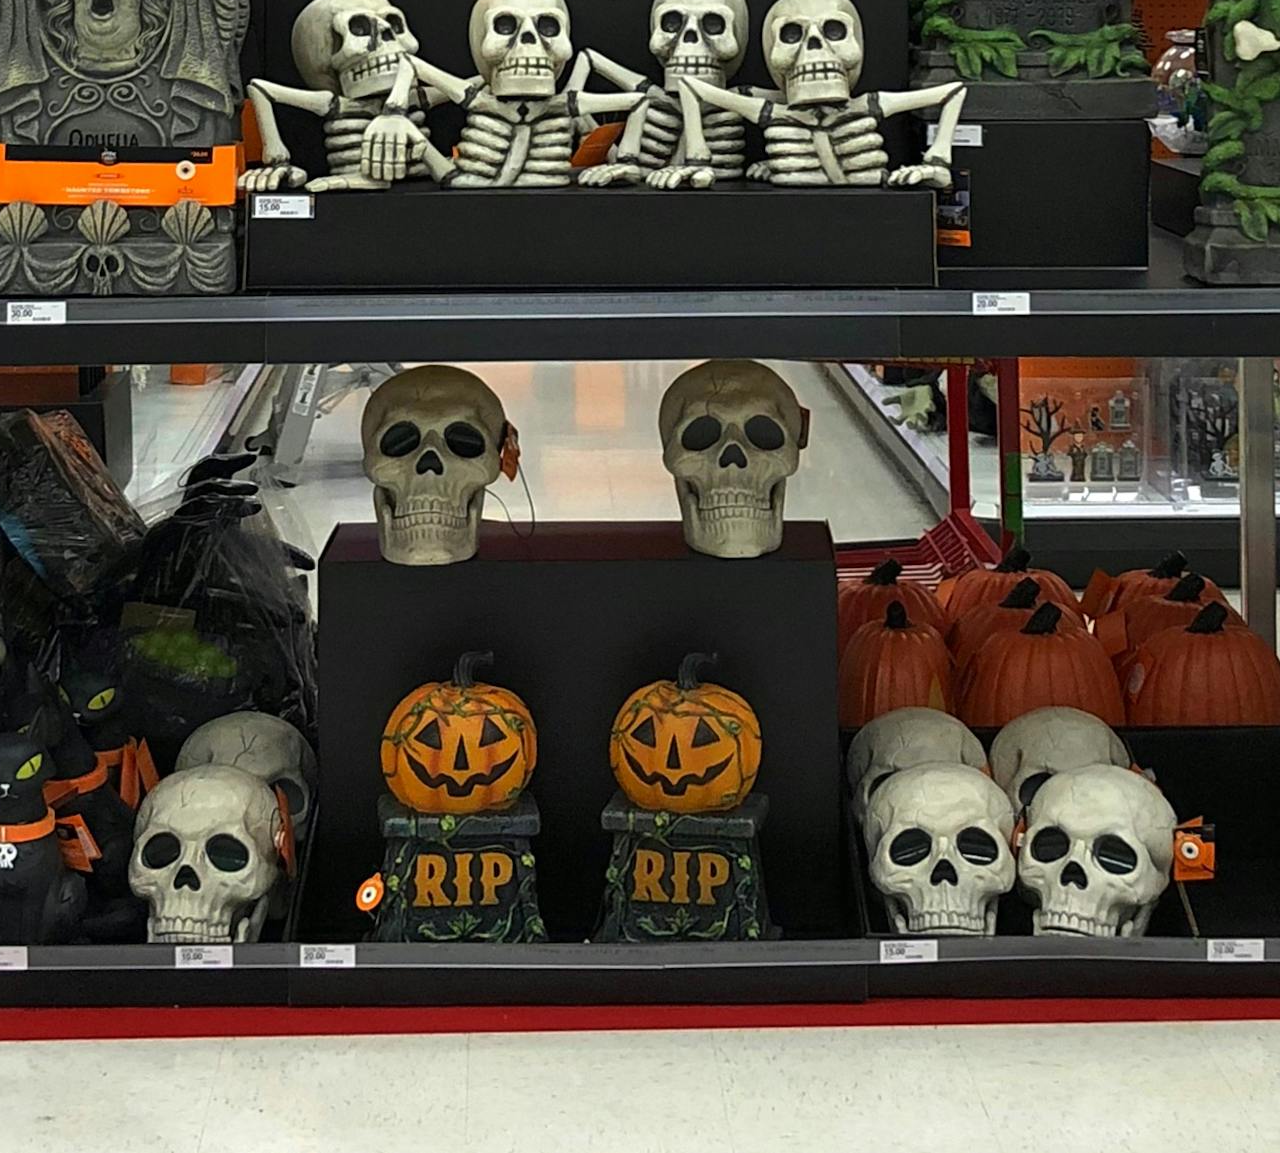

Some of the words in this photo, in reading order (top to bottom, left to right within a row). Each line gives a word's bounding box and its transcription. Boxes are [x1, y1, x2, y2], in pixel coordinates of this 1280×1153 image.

[259, 203, 281, 211] 15.00
[977, 300, 998, 308] 20.00
[413, 851, 513, 908] RIP
[632, 850, 731, 906] RIP
